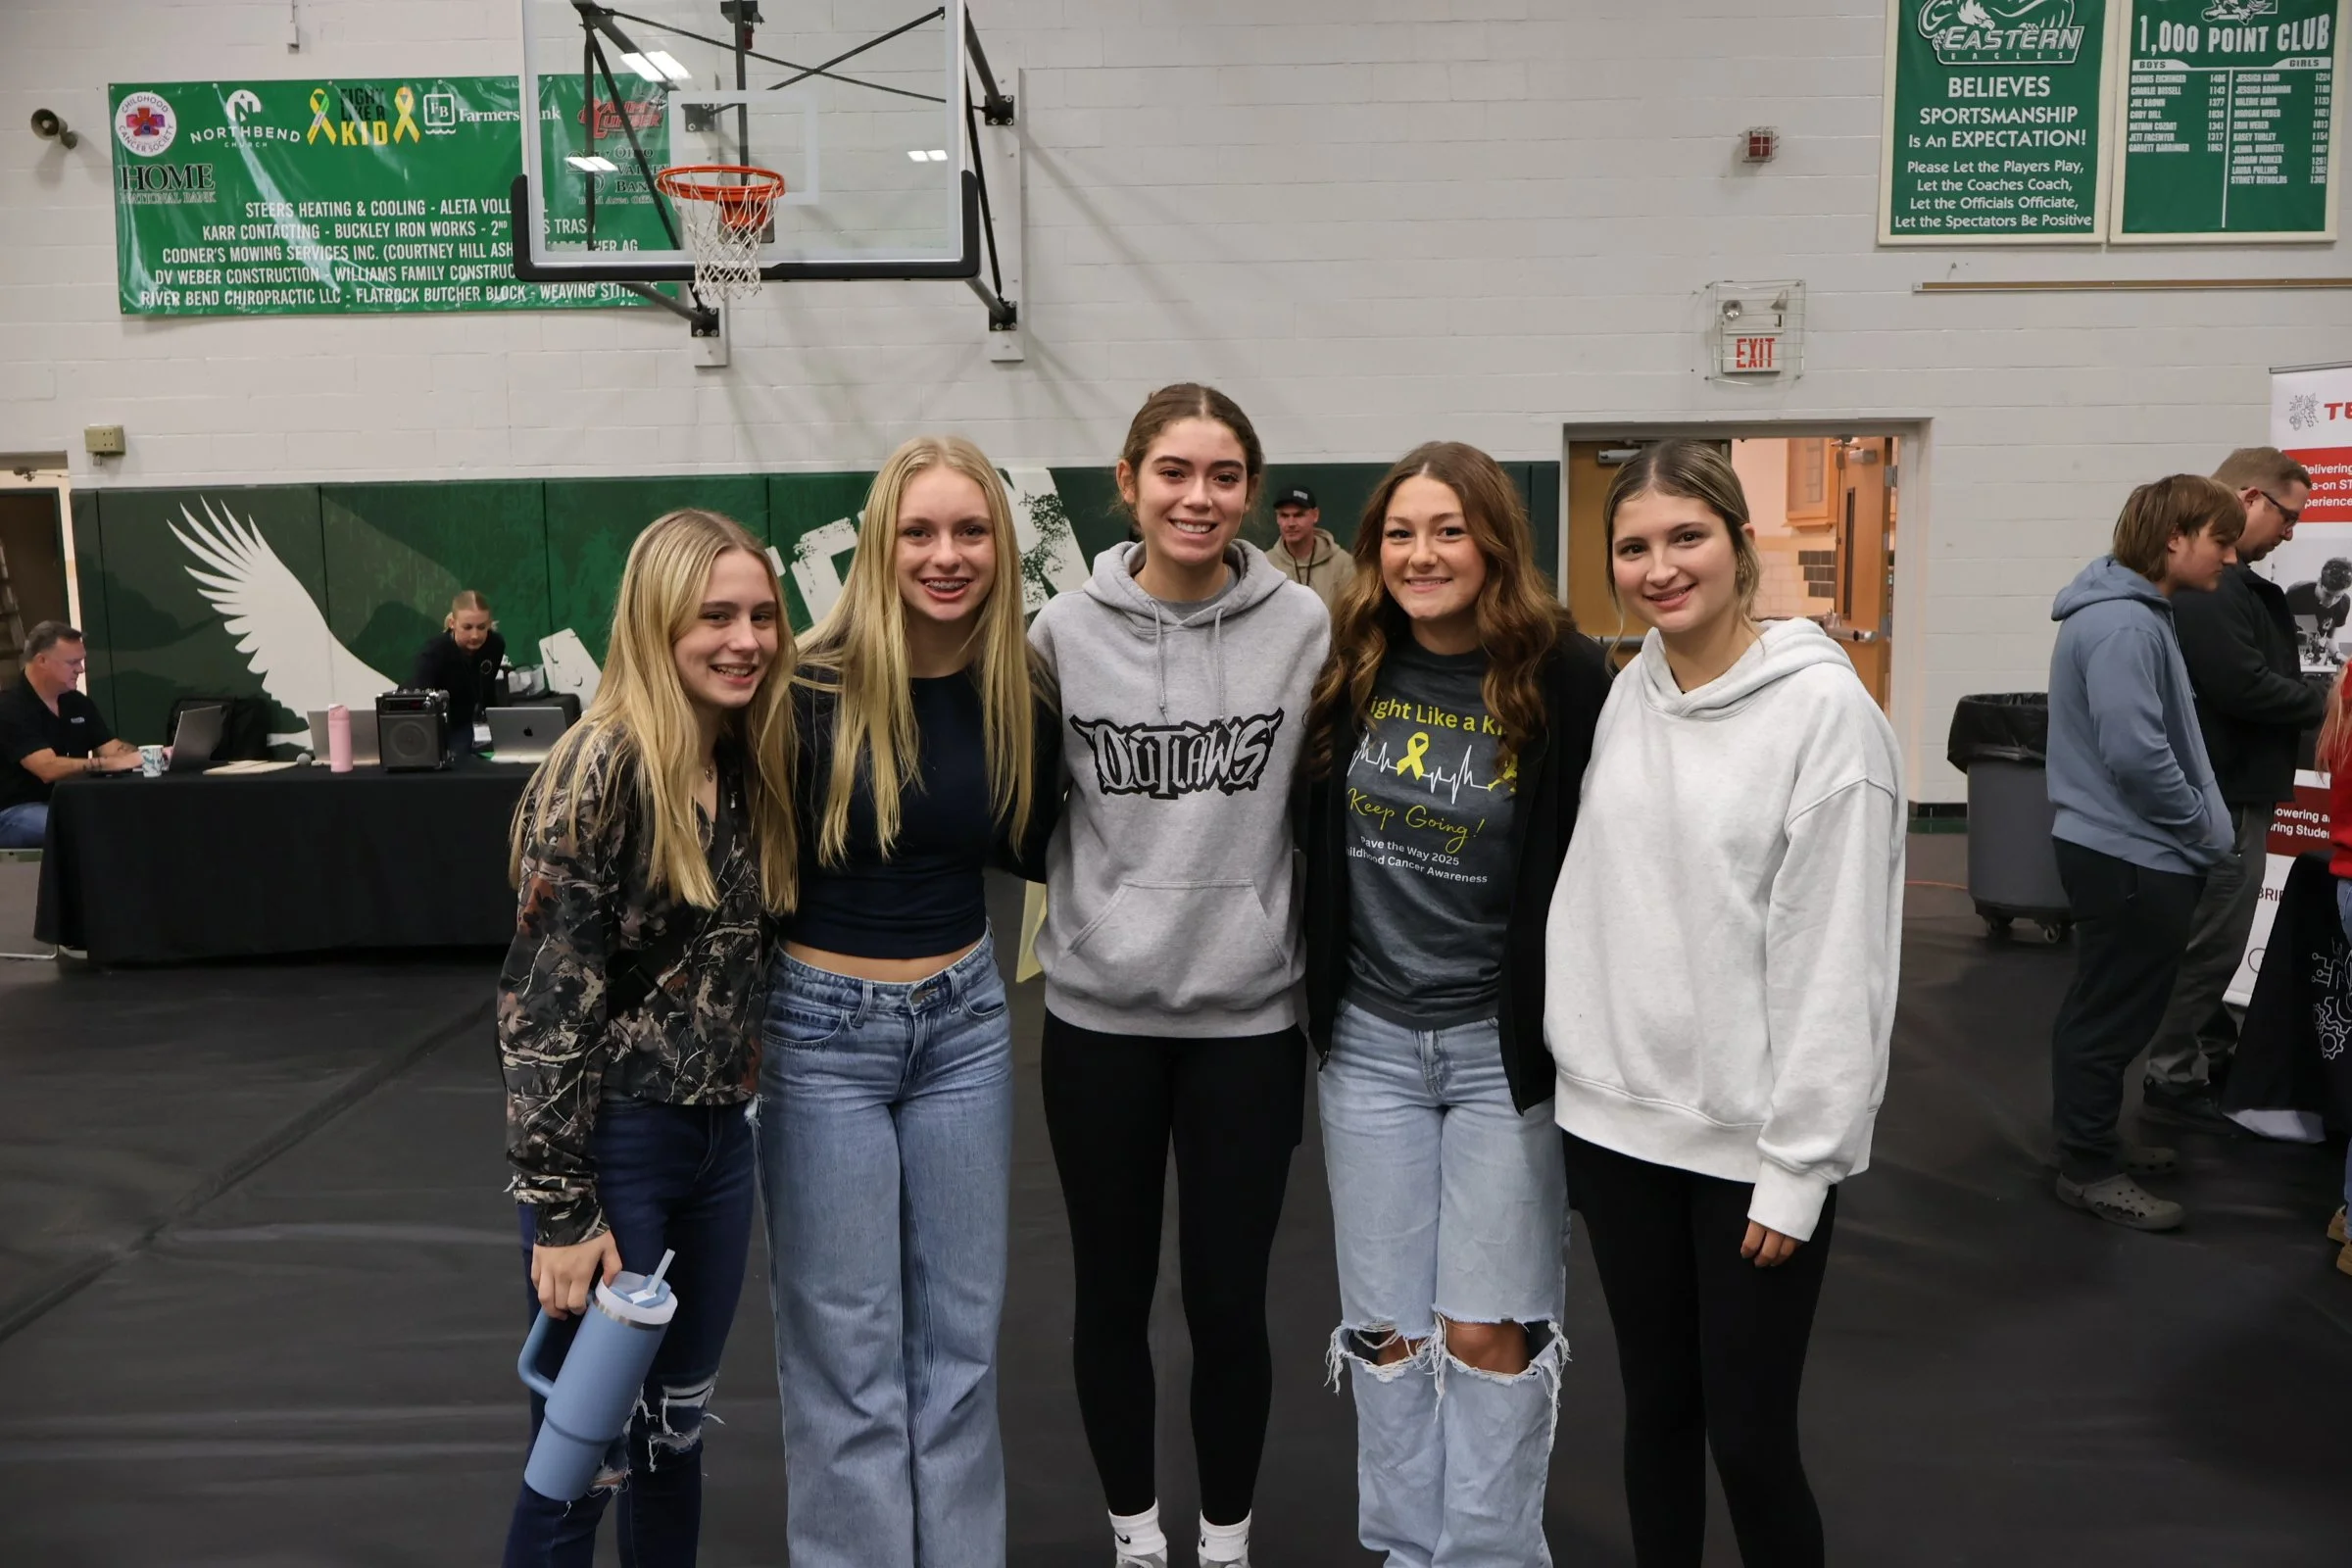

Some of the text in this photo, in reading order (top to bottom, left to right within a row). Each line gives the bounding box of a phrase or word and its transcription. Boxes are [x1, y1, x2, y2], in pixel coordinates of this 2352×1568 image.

[1943, 26, 2080, 50] EASTERN
[2139, 14, 2329, 56] 1,000 POINT CLUB
[1948, 76, 2050, 98] BELIEVES
[122, 95, 169, 114] CHILDHOOD
[459, 108, 520, 122] Farmers
[1920, 106, 2079, 124] SPORTSMANSHIP
[119, 124, 146, 153] CANCER
[148, 123, 173, 153] SOCIETY
[190, 125, 301, 144] NORTHBEND
[340, 121, 388, 146] KID
[1909, 129, 2086, 148] Is An EXPECTATION!
[118, 163, 216, 191] HOME
[1907, 160, 2084, 175] Please Let the Players Play,
[615, 179, 651, 193] BAN
[1917, 178, 2073, 192] Let the Coaches Coach,
[246, 202, 294, 218] STEERS
[299, 201, 352, 217] HEATING
[357, 201, 366, 217] &
[370, 200, 425, 216] COOLING
[440, 199, 477, 215] ALETA
[1910, 196, 2079, 210] Let the Officials Officiate,
[203, 225, 236, 241] KARR
[240, 223, 320, 240] CONTACTING
[335, 222, 390, 239] BUCKLEY
[395, 221, 425, 237] IRON
[430, 220, 476, 236] WORKS
[1895, 215, 2092, 229] Let the Spectators Be Positive
[163, 247, 226, 264] CODNER'S
[230, 246, 281, 262] MOWING
[286, 245, 349, 261] SERVICES
[353, 244, 379, 261] INC.
[383, 243, 454, 262] (COURTNEY
[459, 243, 486, 258] HILL
[156, 270, 172, 284] DV
[177, 270, 221, 284] WEBER
[226, 267, 320, 284] CONSTRUCTION
[334, 267, 397, 282] WILLIAMS
[401, 266, 445, 281] FAMILY
[140, 291, 180, 306] RIVER
[186, 291, 220, 306] BEND
[224, 288, 316, 305] CHIROPRACTIC
[318, 288, 341, 304] LLC
[356, 287, 419, 304] FLATROCK
[423, 286, 480, 303] BUTCHER
[486, 285, 525, 301] BLOCK
[540, 284, 596, 300] WEAVING
[1736, 337, 1776, 368] EXIT
[1370, 696, 1411, 719] ight
[1416, 705, 1457, 728] Like
[1463, 715, 1476, 731] a
[1069, 708, 1285, 800] OUTLAWS
[1348, 787, 1396, 831] Keep
[1387, 841, 1404, 853] the
[1407, 846, 1430, 861] Way
[1432, 853, 1459, 866] 2025
[1388, 857, 1425, 872] Cancer
[1427, 866, 1488, 883] Awareness
